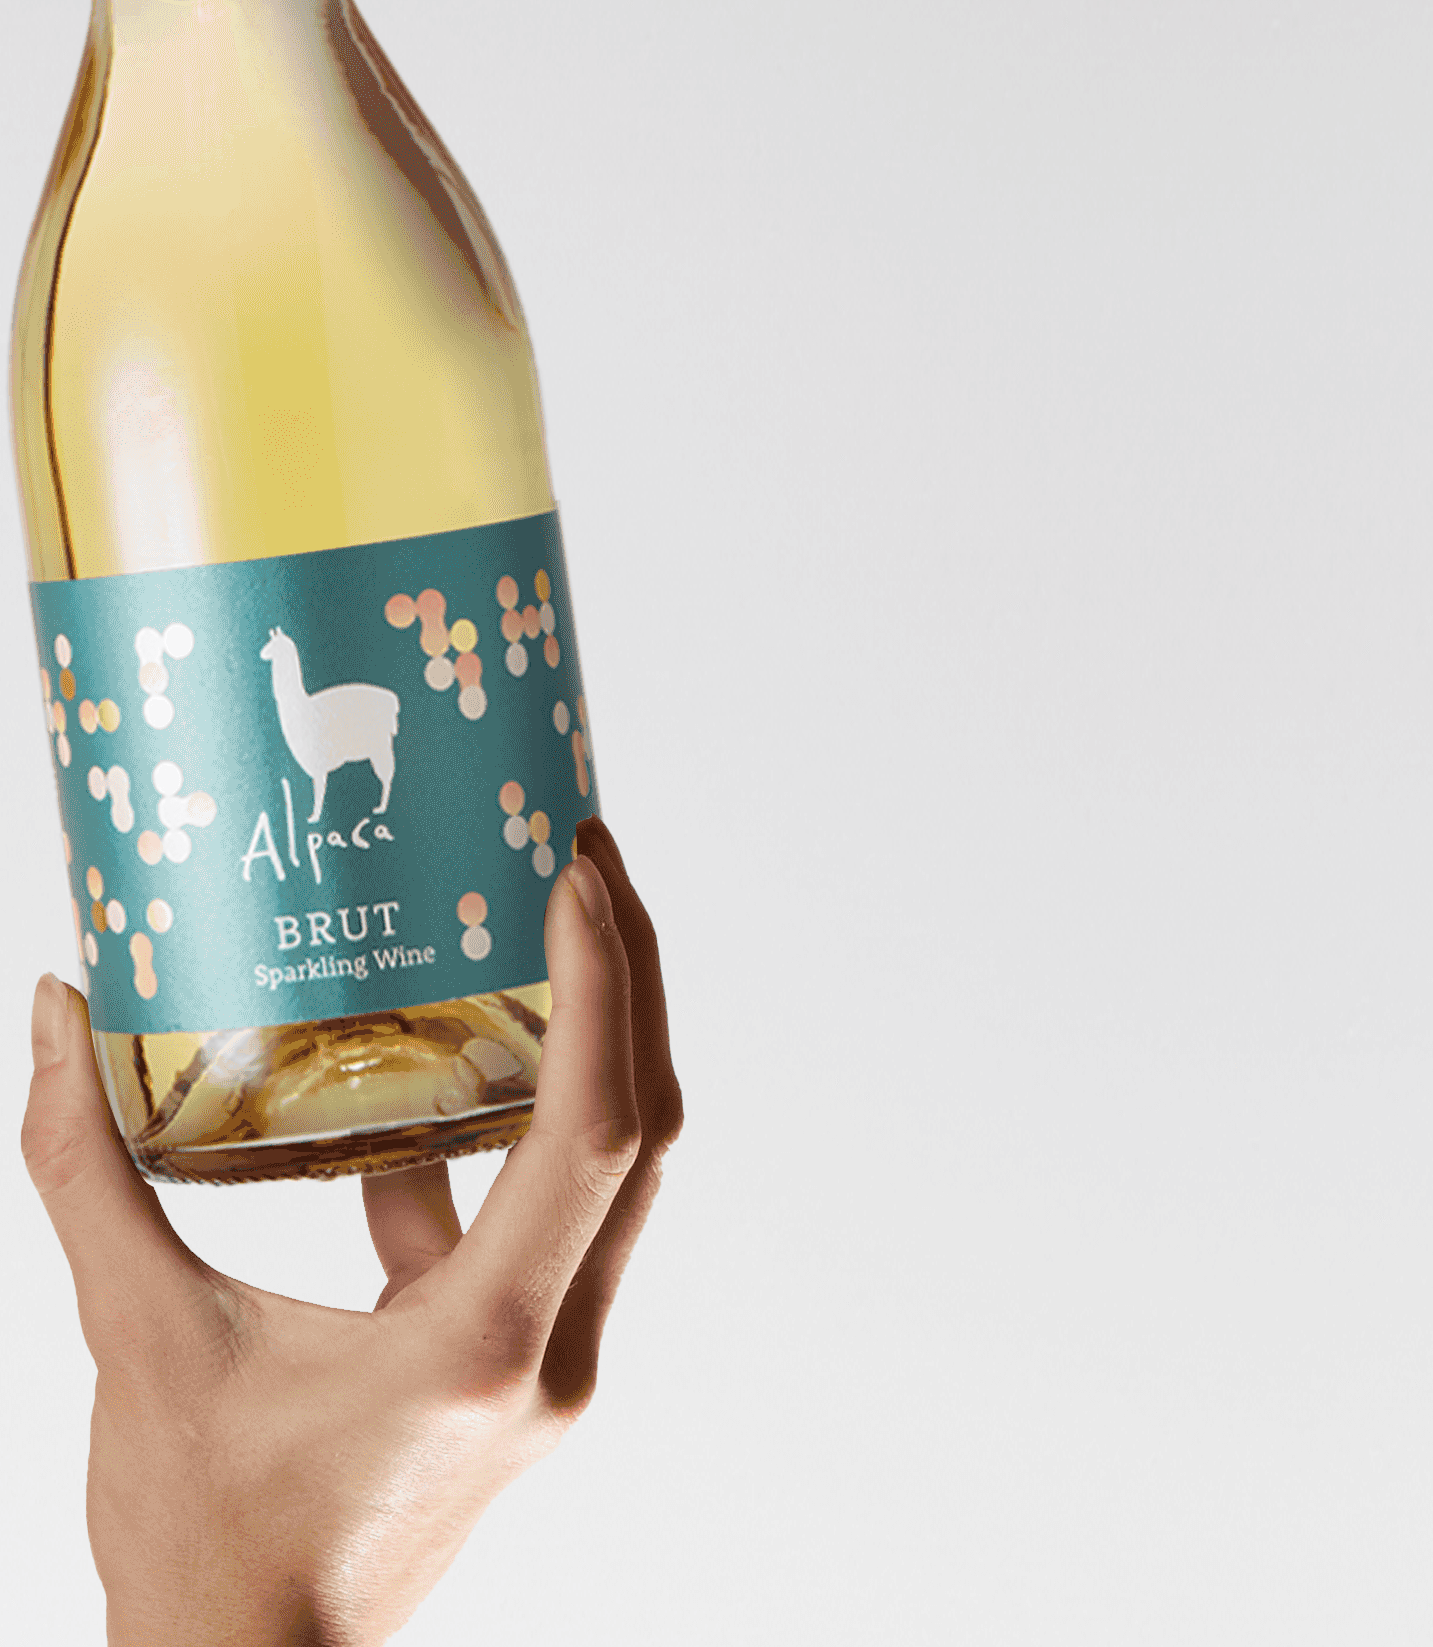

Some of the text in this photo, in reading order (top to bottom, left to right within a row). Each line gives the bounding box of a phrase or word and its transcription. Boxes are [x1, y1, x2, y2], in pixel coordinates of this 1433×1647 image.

[241, 777, 395, 885] Alpaca
[274, 901, 400, 950] BRUT
[253, 944, 436, 991] Sparkling Wine
